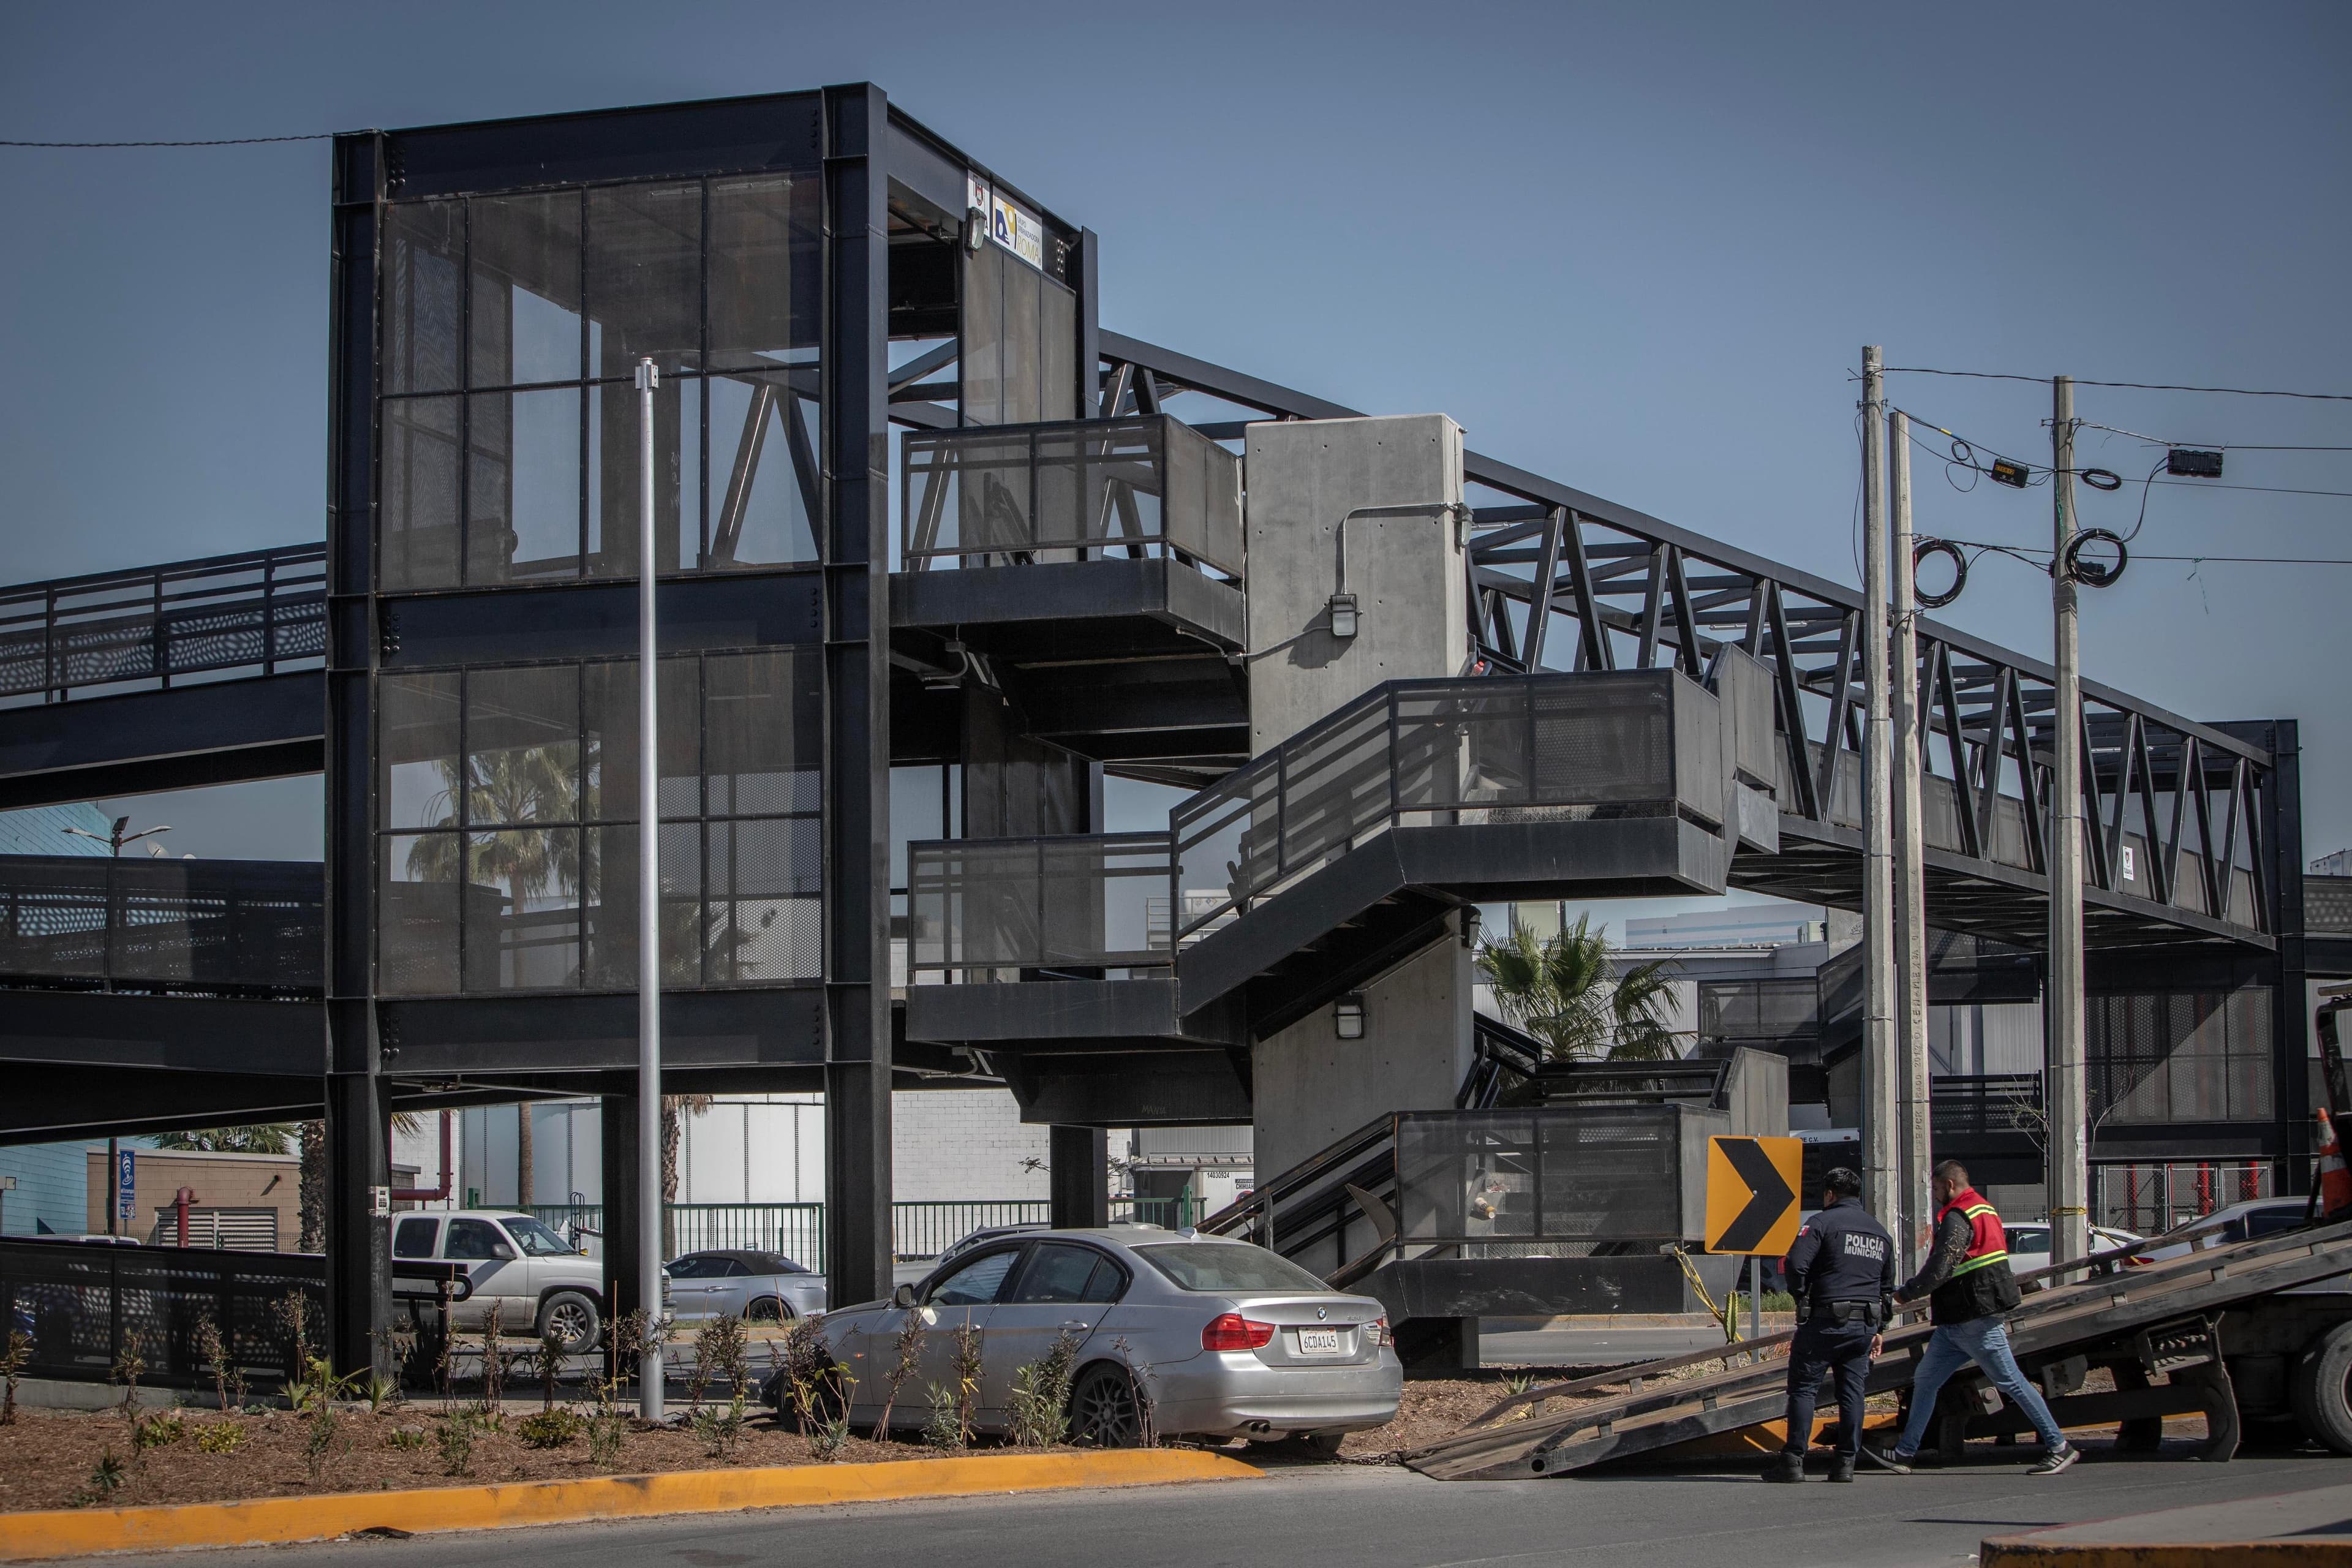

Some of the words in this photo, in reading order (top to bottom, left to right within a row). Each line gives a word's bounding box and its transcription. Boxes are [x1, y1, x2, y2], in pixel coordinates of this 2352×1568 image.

[1017, 235, 1039, 261] ROMA
[1845, 1234, 1884, 1253] POLICÍA
[1844, 1245, 1883, 1261] MUNICIPAL
[1304, 1335, 1336, 1348] 6CDA145
